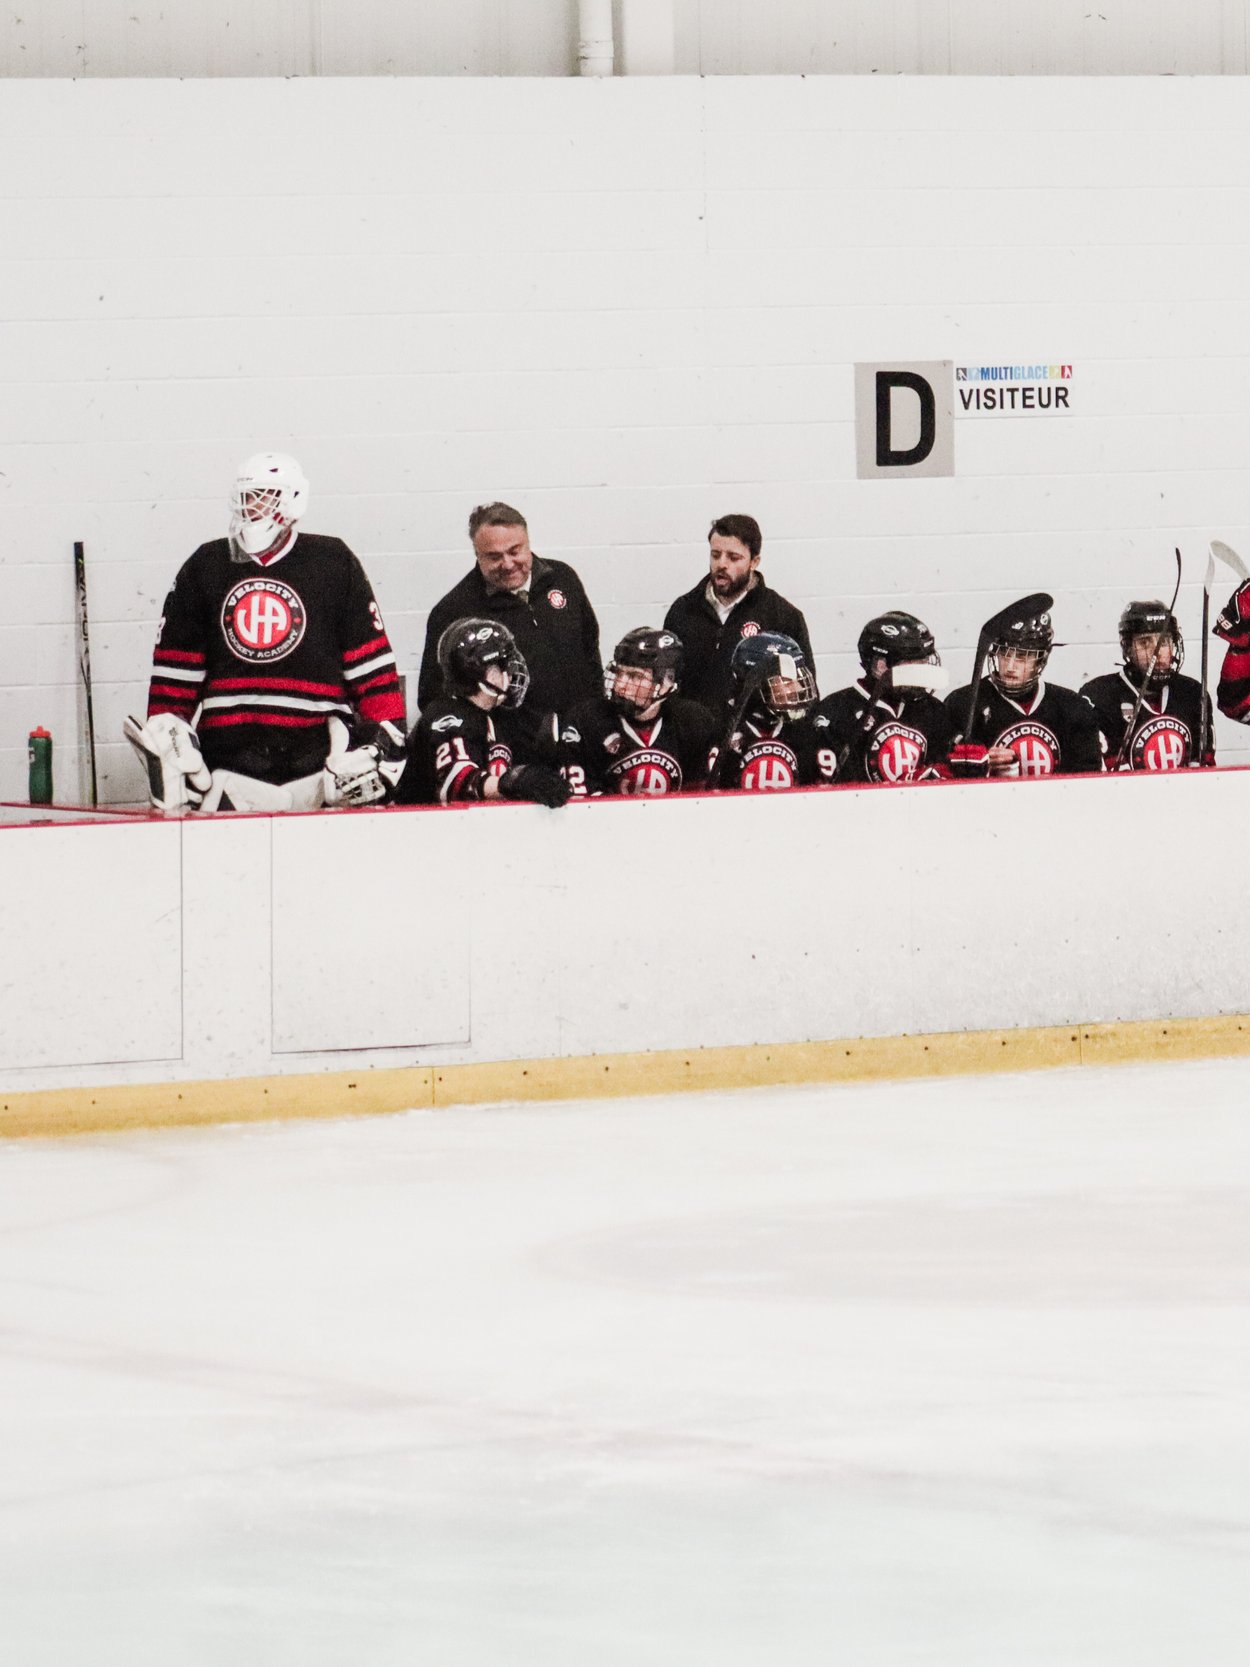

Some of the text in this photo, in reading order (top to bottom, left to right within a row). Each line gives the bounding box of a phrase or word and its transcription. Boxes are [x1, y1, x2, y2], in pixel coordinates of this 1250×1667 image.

[981, 365, 1048, 380] MULTIGLACE
[959, 387, 1070, 410] VISITEUR
[876, 371, 935, 467] D
[228, 582, 299, 608] VELOCITY
[257, 629, 298, 658] ACADEMY
[871, 726, 926, 753] VELOCITY
[1001, 726, 1058, 751] ELOCITY
[1135, 720, 1190, 748] VELOCITY
[436, 737, 470, 770] 21
[613, 754, 680, 780] VELOCITY
[817, 749, 837, 777] 9
